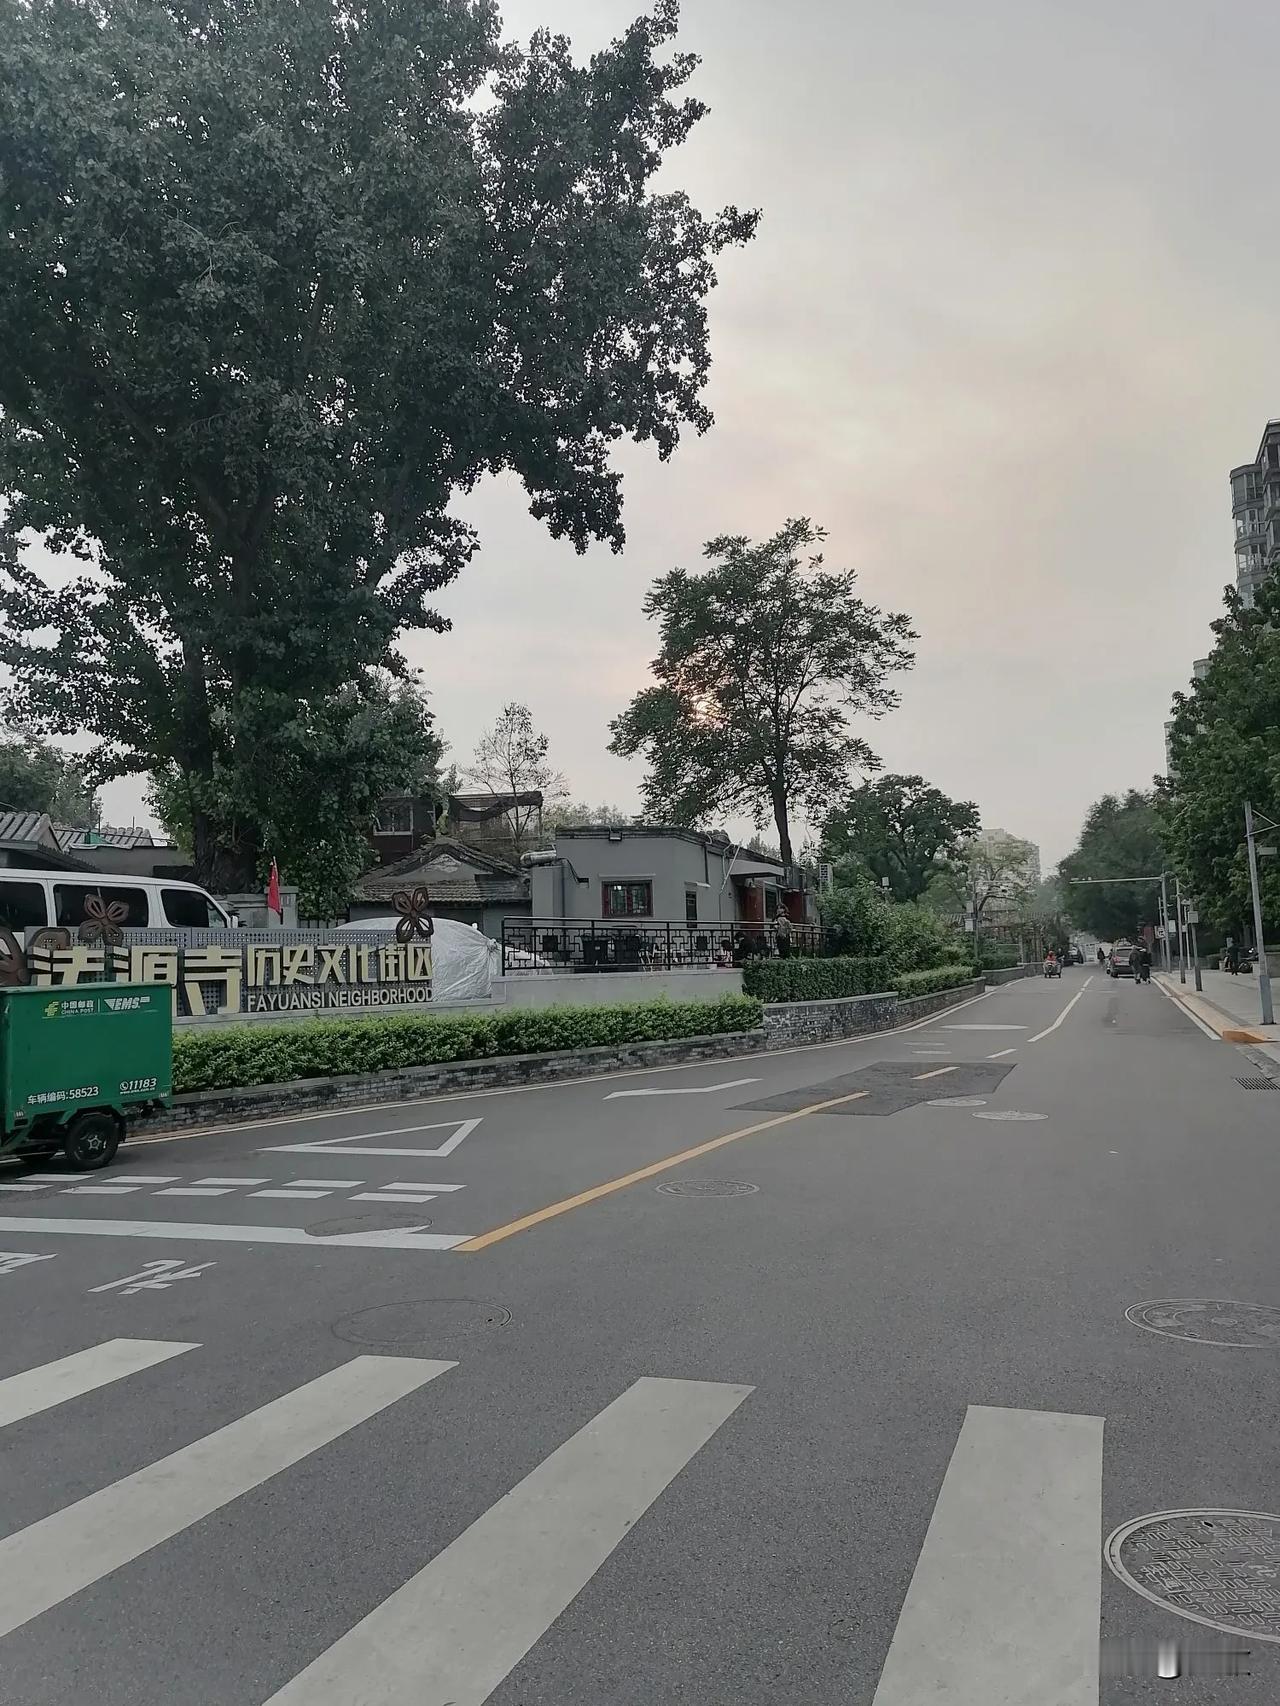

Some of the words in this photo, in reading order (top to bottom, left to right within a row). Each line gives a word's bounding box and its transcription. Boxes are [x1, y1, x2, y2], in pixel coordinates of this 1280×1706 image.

[247, 943, 433, 987] 历史文化街区
[61, 1000, 94, 1010] 中国邮政
[248, 991, 325, 1012] FAYUANSI
[329, 987, 433, 1008] NEIGHBORHOOD
[129, 1078, 157, 1090] 11183
[27, 1086, 99, 1105] 车辆编码:58523
